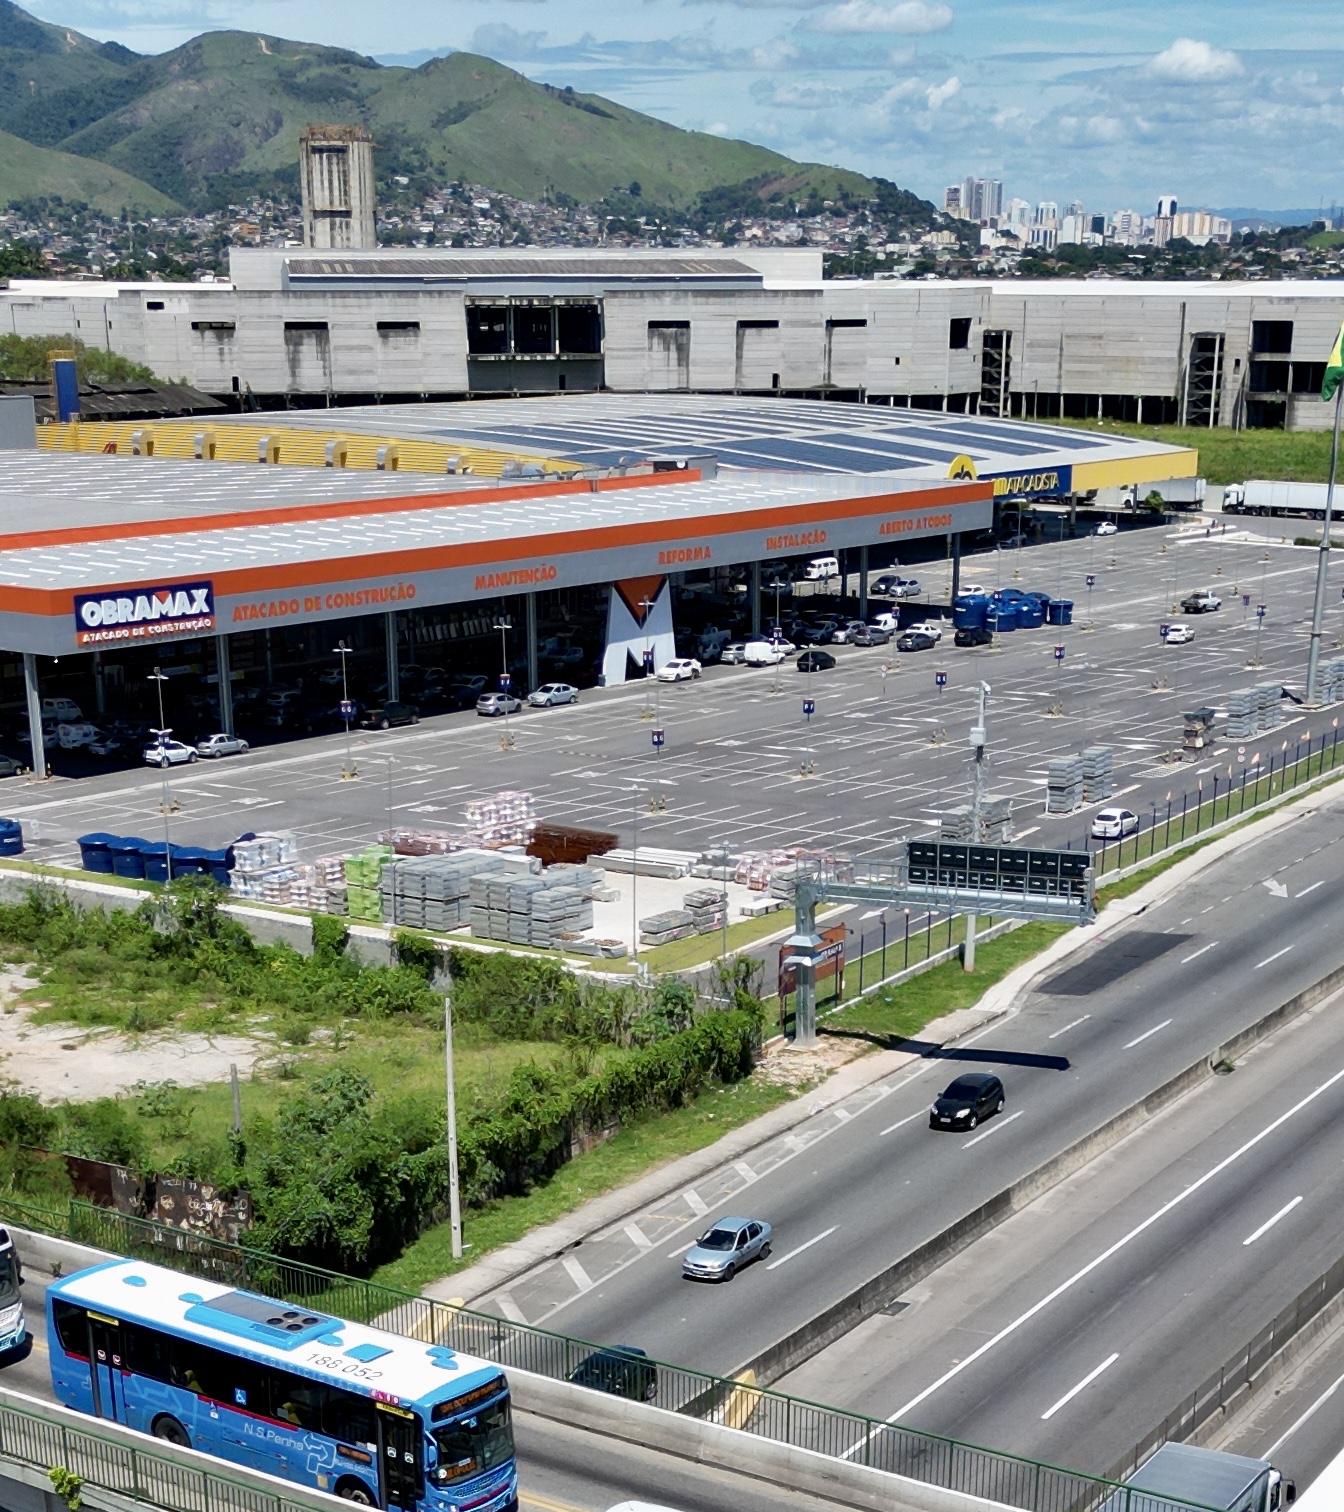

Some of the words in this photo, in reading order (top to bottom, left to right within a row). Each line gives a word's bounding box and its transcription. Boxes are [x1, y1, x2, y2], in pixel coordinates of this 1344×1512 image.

[1007, 473, 1060, 494] ATACADISTA
[879, 518, 913, 535] ABERTO
[915, 517, 924, 530] A
[925, 514, 953, 528] TODOS
[766, 529, 827, 550] INSTALAÇÃO
[658, 546, 712, 565] REFORMA
[474, 563, 557, 591] MANUTENÇÃO
[82, 589, 210, 627] OBRAMAX
[233, 602, 301, 622] ATACADO
[304, 596, 321, 612] DE
[325, 582, 416, 610] CONSTRUÇÃO
[82, 629, 129, 643] ATACADO
[132, 626, 145, 636] DE
[148, 618, 212, 634] CONSTRUÇÃO
[306, 1353, 343, 1369] 188
[342, 1364, 384, 1382] 052
